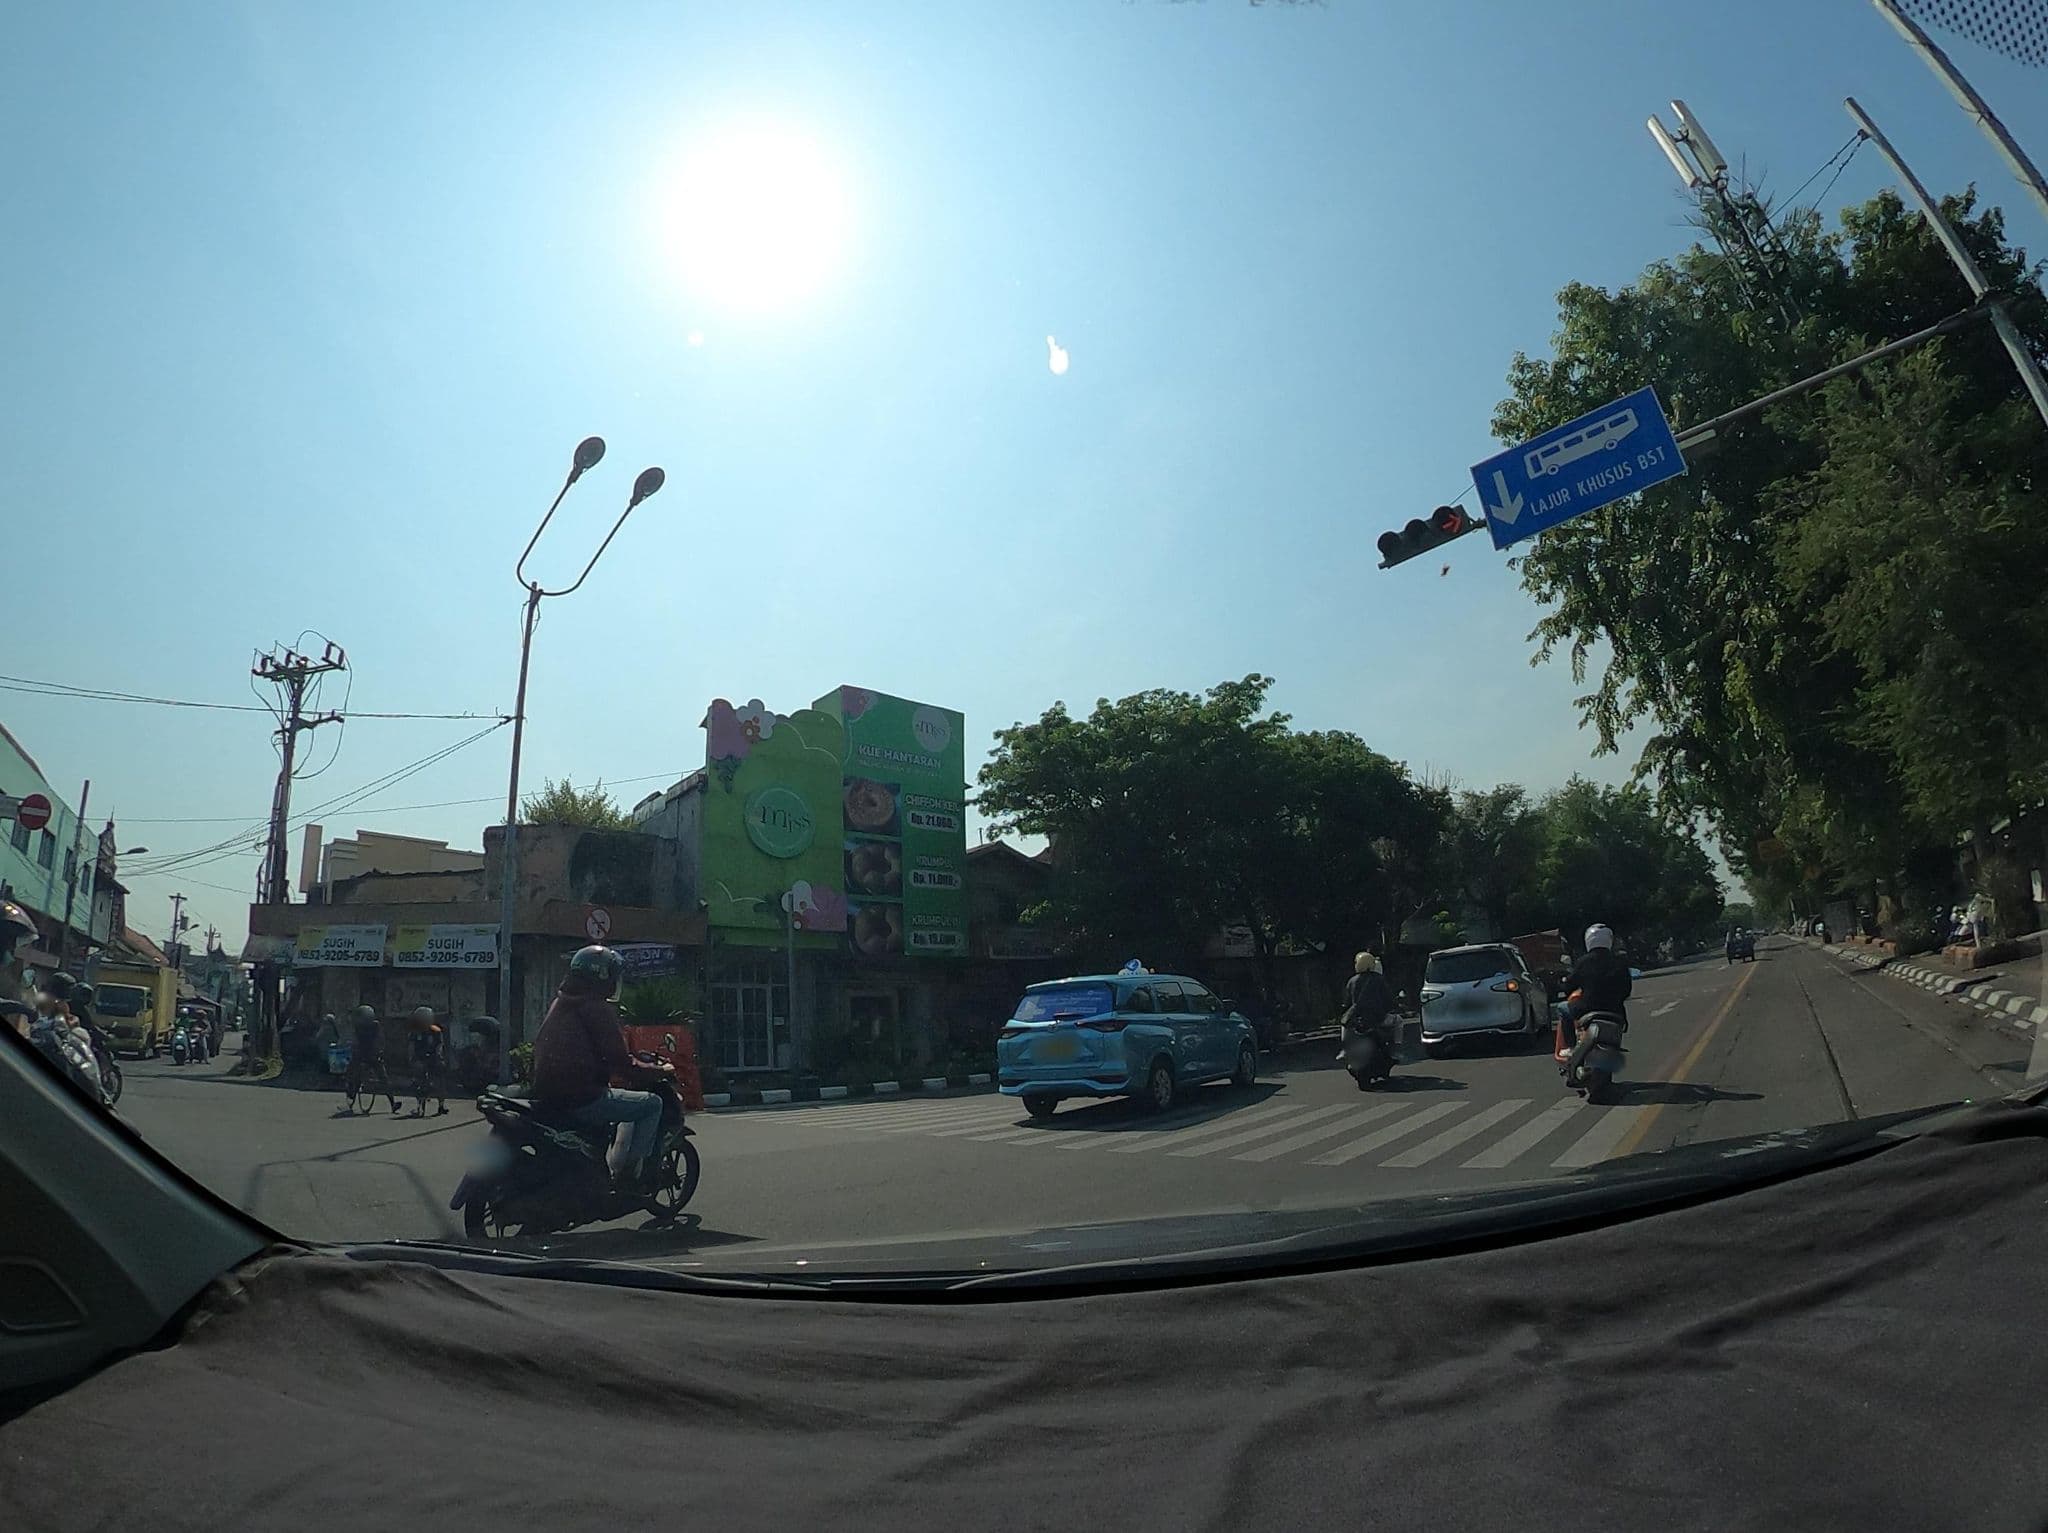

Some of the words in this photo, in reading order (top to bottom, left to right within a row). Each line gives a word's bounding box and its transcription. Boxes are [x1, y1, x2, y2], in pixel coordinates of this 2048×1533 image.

[1530, 488, 1571, 516] LAJUR
[1576, 461, 1633, 497] KHUSUS
[1637, 446, 1666, 470] BST
[858, 743, 881, 758] KUE
[884, 748, 941, 769] HANTARAN
[323, 938, 355, 949] SUGIH
[427, 938, 464, 950] SUGIH
[398, 951, 495, 963] 0852-9205-6789
